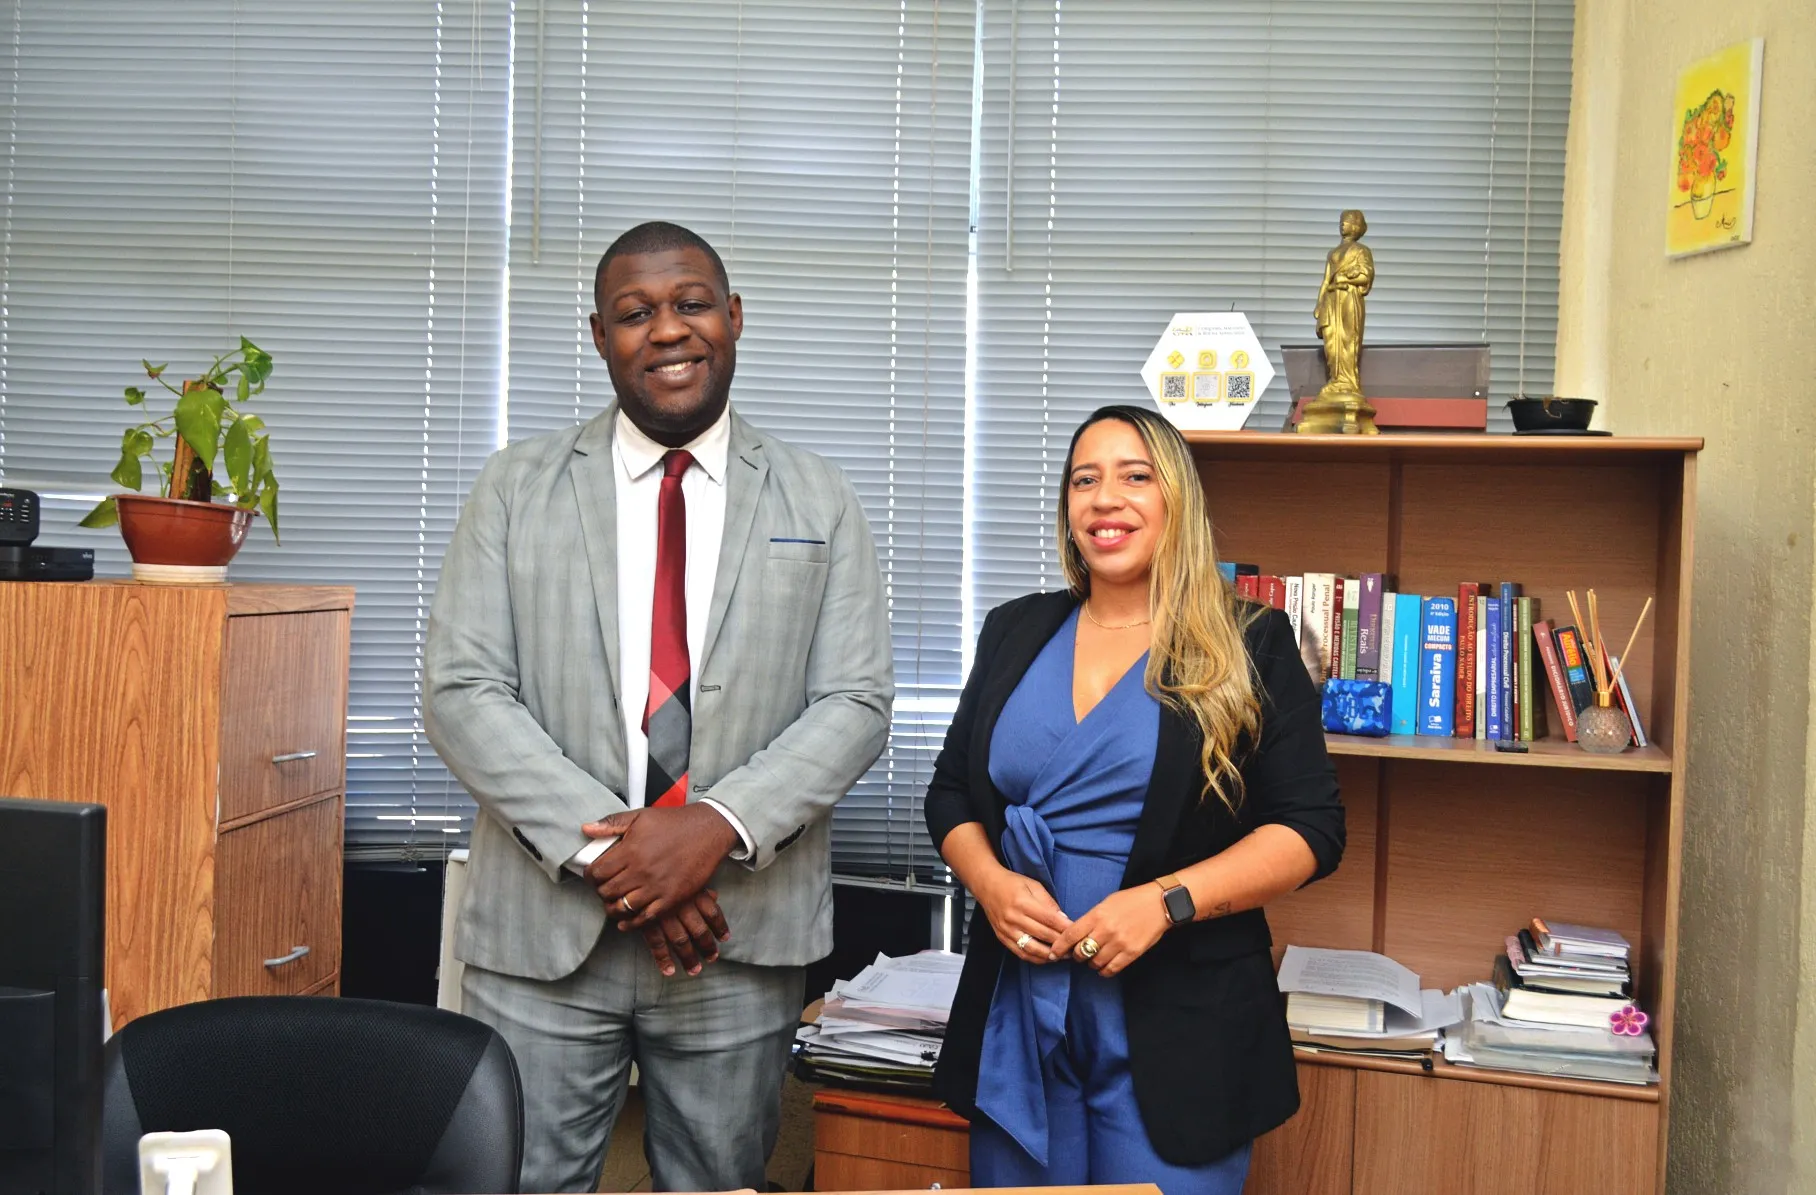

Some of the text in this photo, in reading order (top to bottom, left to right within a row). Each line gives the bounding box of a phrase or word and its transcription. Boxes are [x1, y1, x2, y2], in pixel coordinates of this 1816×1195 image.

[1322, 584, 1331, 606] Penal
[1430, 603, 1450, 611] 2010
[1467, 594, 1475, 640] INTRODUÇÃO
[1320, 610, 1330, 652] Processual
[1334, 612, 1342, 630] PRISÃO
[1427, 624, 1451, 635] VADE
[1359, 629, 1369, 654] Reais
[1424, 643, 1453, 651] COMPACTO
[1427, 634, 1451, 642] MECUM
[1467, 641, 1474, 652] AO
[1562, 634, 1577, 666] Aurélio
[1466, 653, 1474, 680] ESTUDO
[1428, 653, 1443, 708] Saraiva
[1465, 681, 1472, 692] DO
